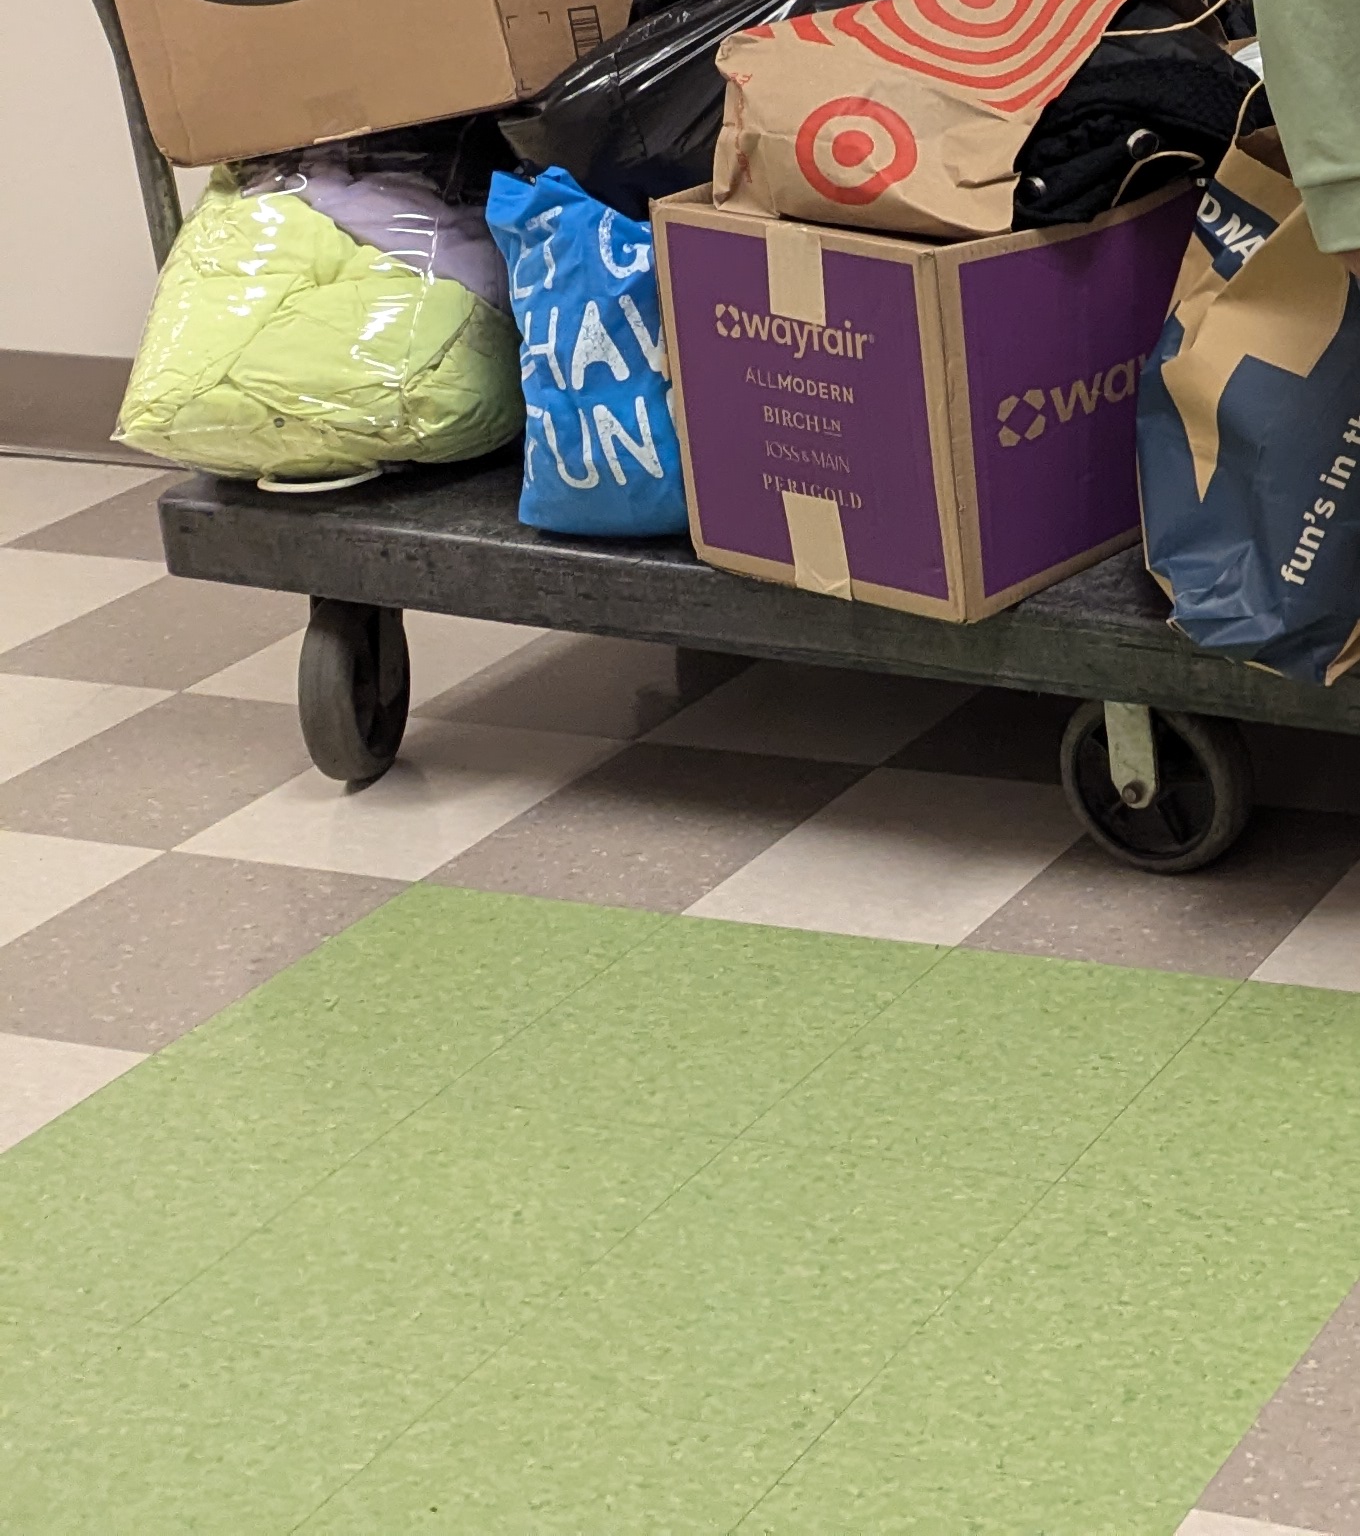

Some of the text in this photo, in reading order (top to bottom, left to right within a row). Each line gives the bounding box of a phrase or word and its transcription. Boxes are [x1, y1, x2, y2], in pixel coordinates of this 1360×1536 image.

[745, 366, 855, 404] ALLMODERN
[1281, 497, 1338, 586] fun's
[1319, 455, 1359, 491] in
